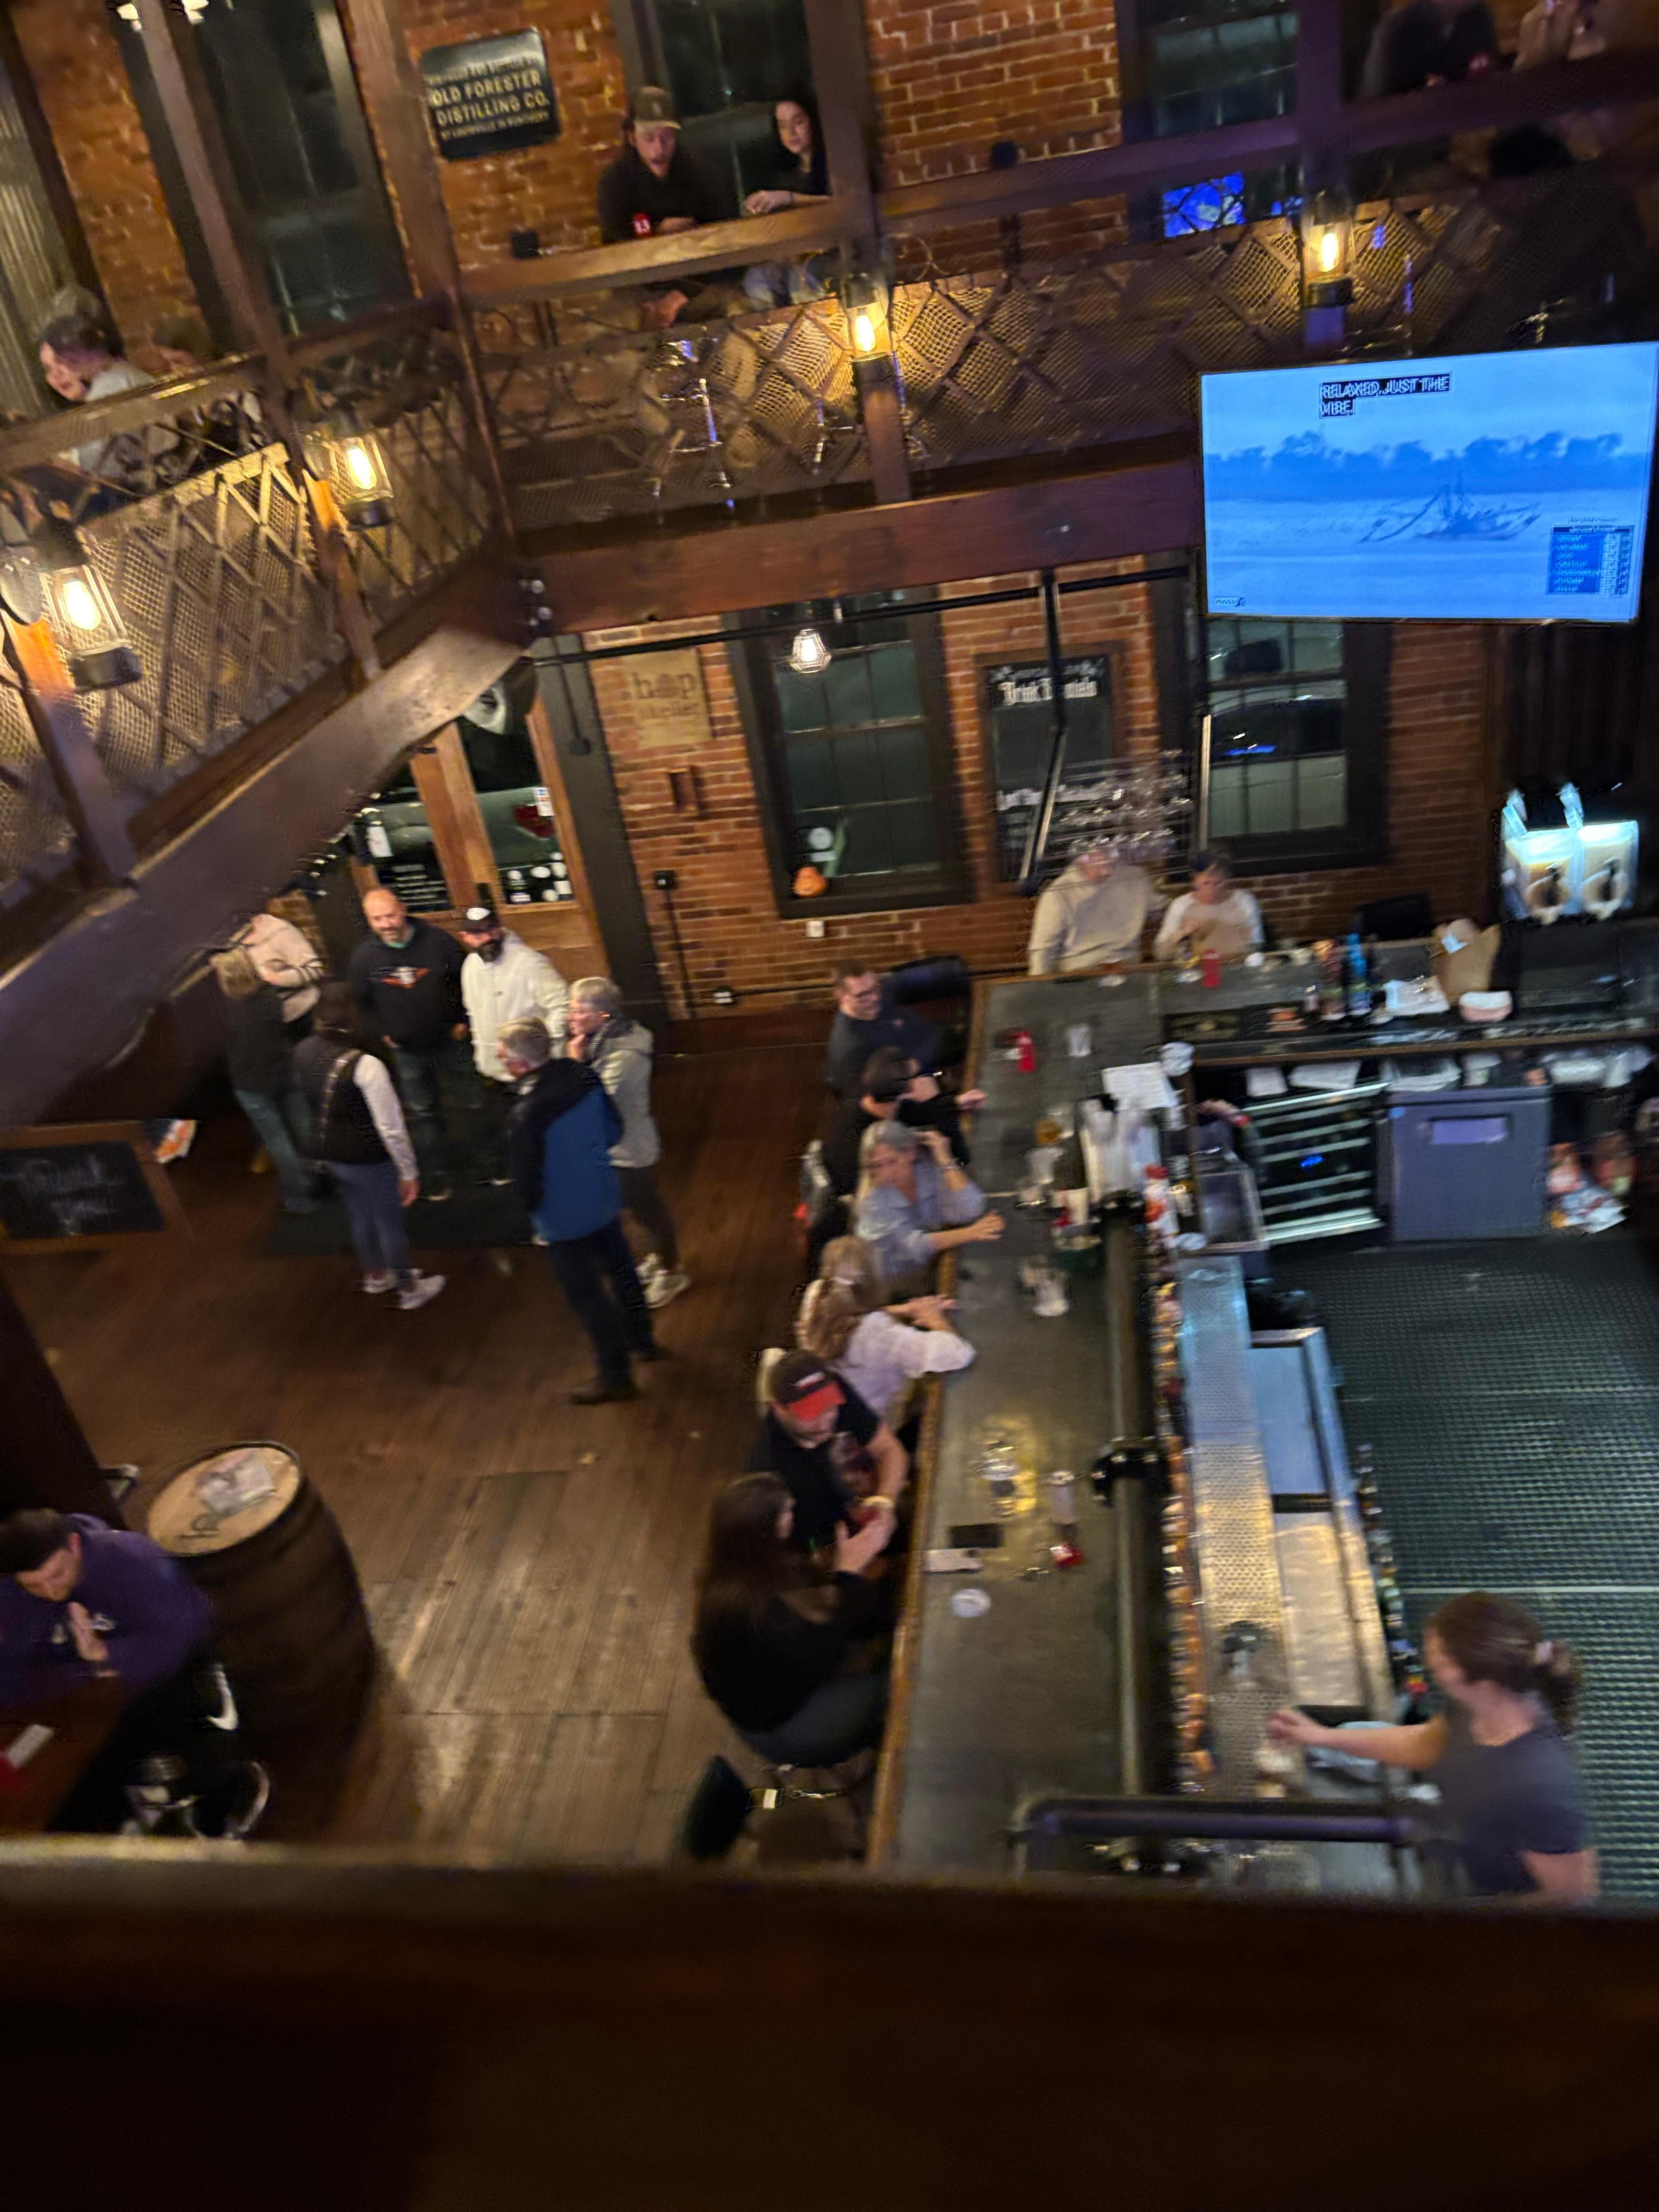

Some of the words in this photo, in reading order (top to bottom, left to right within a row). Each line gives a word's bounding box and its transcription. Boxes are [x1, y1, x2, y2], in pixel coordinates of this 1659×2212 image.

[431, 85, 461, 106] OLD
[464, 69, 541, 100] FORESTER
[436, 94, 520, 127] DISTILLING
[524, 89, 550, 108] CO.
[1320, 381, 1381, 399] RELAXED,
[1383, 378, 1419, 394] JUST
[1419, 376, 1449, 392] THE
